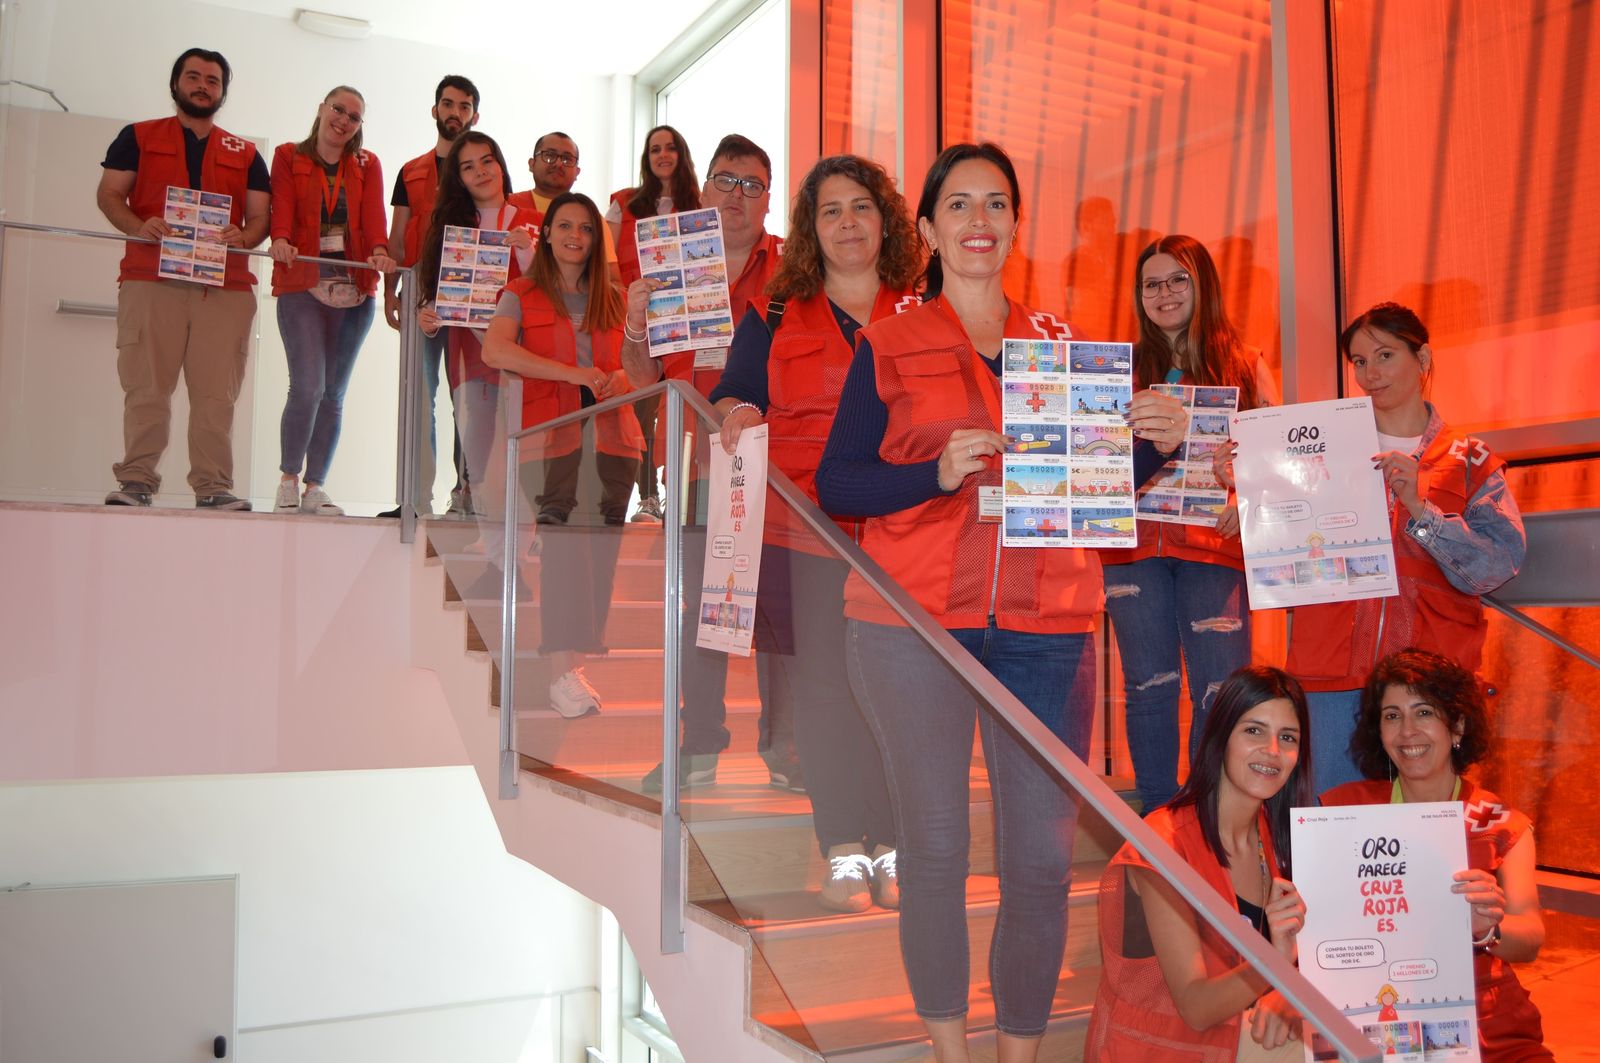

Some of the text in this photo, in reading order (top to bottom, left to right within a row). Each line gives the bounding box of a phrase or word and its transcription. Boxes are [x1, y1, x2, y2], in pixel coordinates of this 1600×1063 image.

[1288, 426, 1319, 443] ORO
[1286, 442, 1326, 456] PARECE
[1362, 837, 1400, 859] ORO
[1358, 862, 1406, 878] PARECE
[1360, 879, 1404, 896] CRUZ
[1363, 896, 1409, 916] ROJA
[1377, 919, 1398, 932] ES.
[1384, 1023, 1408, 1031] 00000
[1439, 1021, 1460, 1029] 00000
